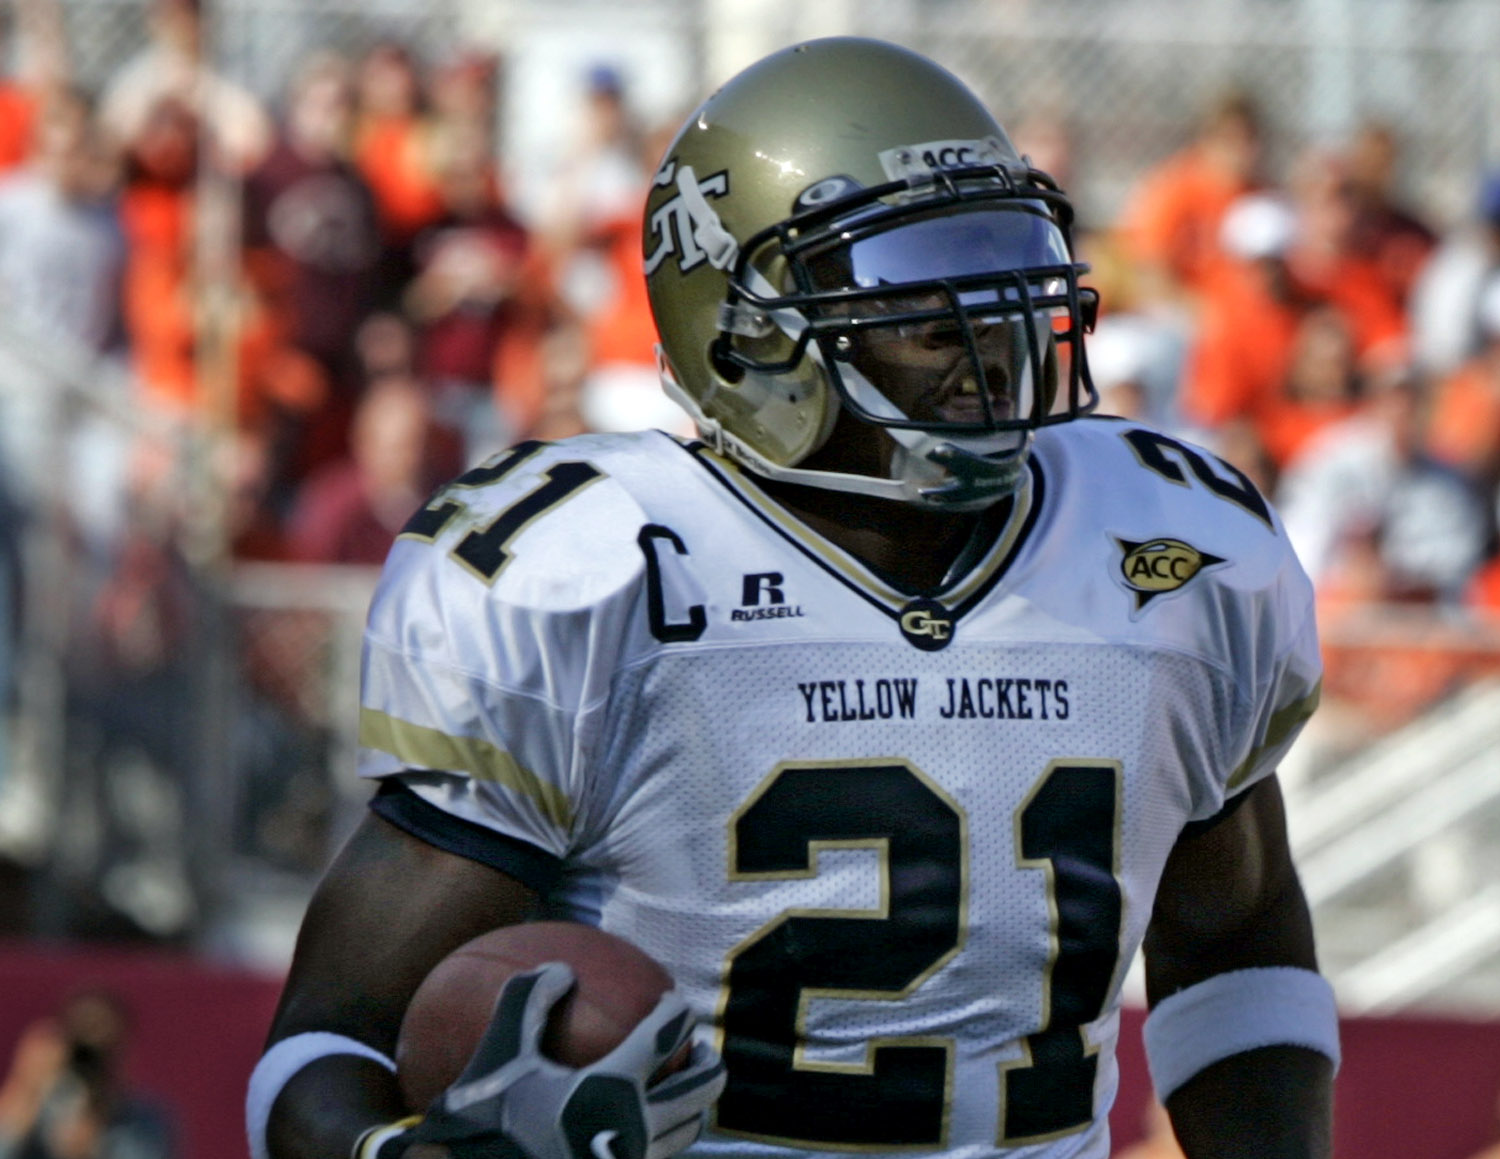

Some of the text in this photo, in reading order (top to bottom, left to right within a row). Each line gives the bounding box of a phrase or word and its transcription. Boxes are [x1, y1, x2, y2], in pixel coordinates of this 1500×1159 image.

[922, 147, 975, 168] ACC
[396, 439, 611, 589] 21
[637, 524, 707, 643] C
[1130, 555, 1189, 582] ACC
[742, 572, 785, 606] R
[730, 606, 805, 622] RUSSELL
[901, 610, 950, 640] GT
[798, 678, 1070, 722] YELLOW JACKETS
[712, 757, 1129, 1152] 21
